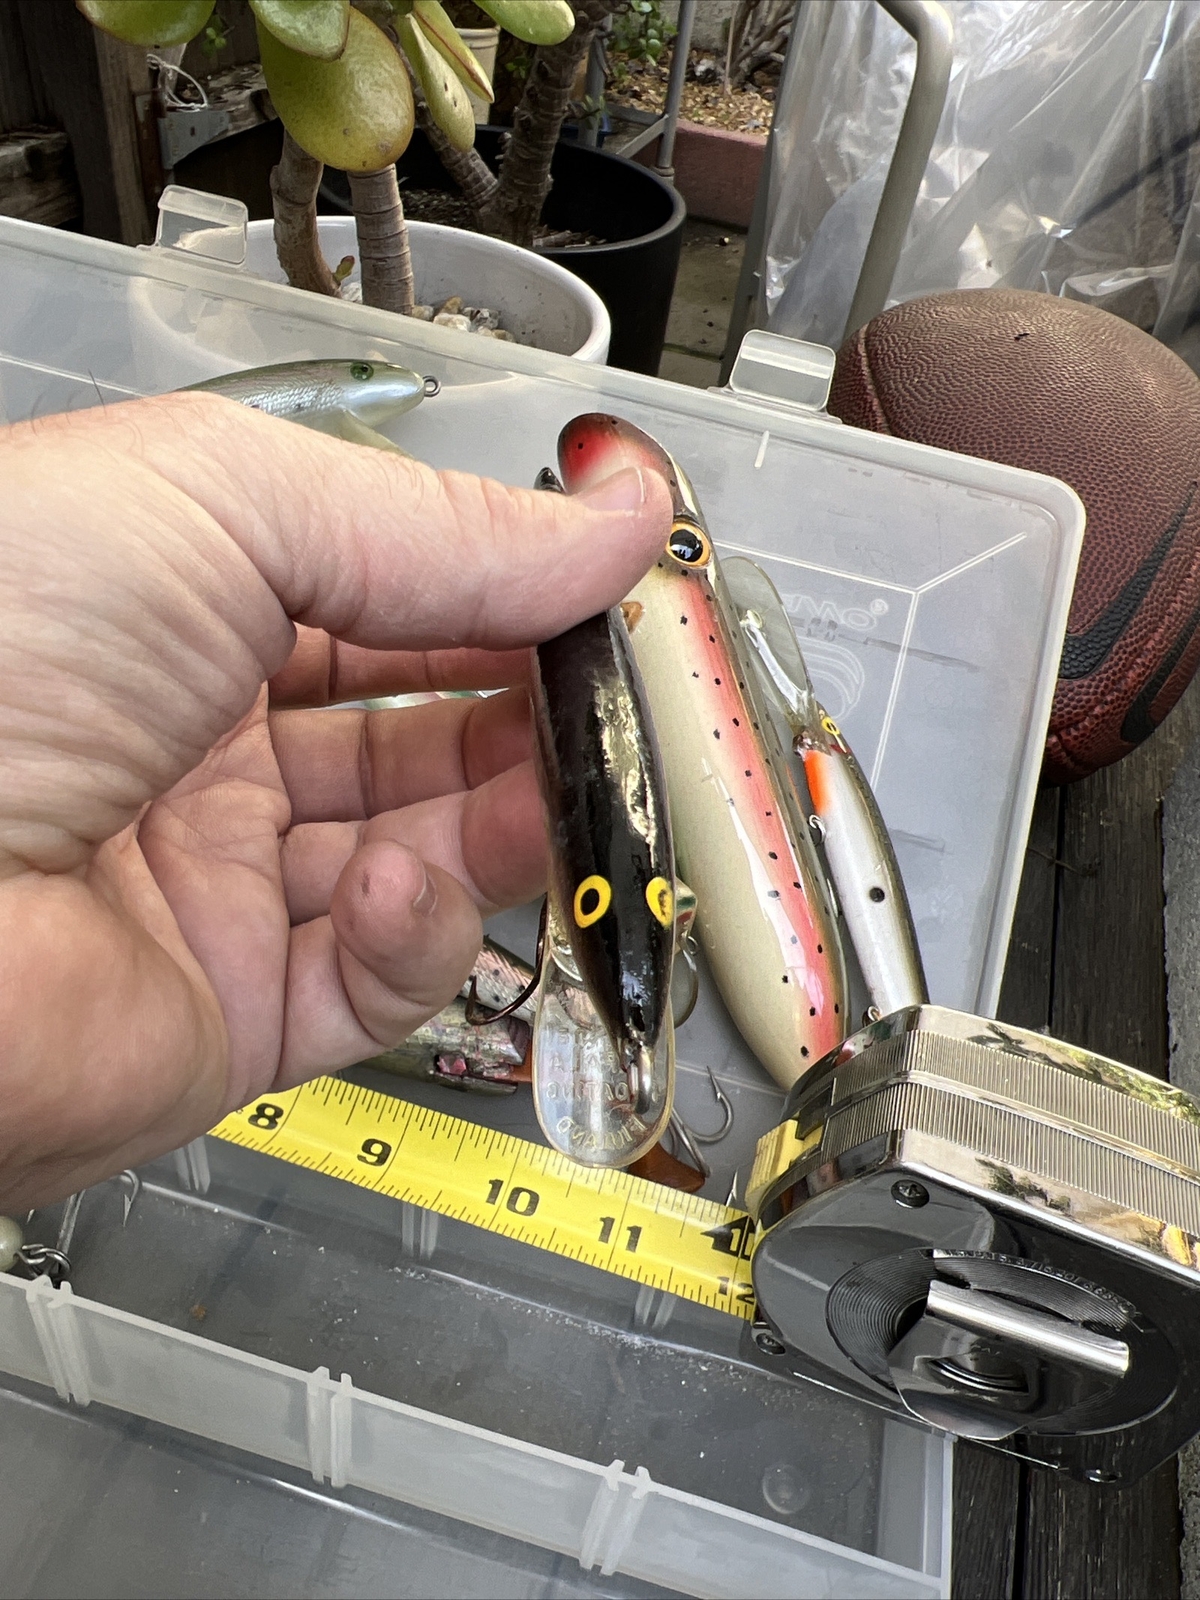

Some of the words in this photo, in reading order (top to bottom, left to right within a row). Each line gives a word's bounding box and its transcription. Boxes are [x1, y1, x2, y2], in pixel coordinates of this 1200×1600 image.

[247, 1102, 284, 1130] 8
[356, 1138, 392, 1167] 9
[486, 1178, 540, 1217] 10
[598, 1216, 642, 1253] 11
